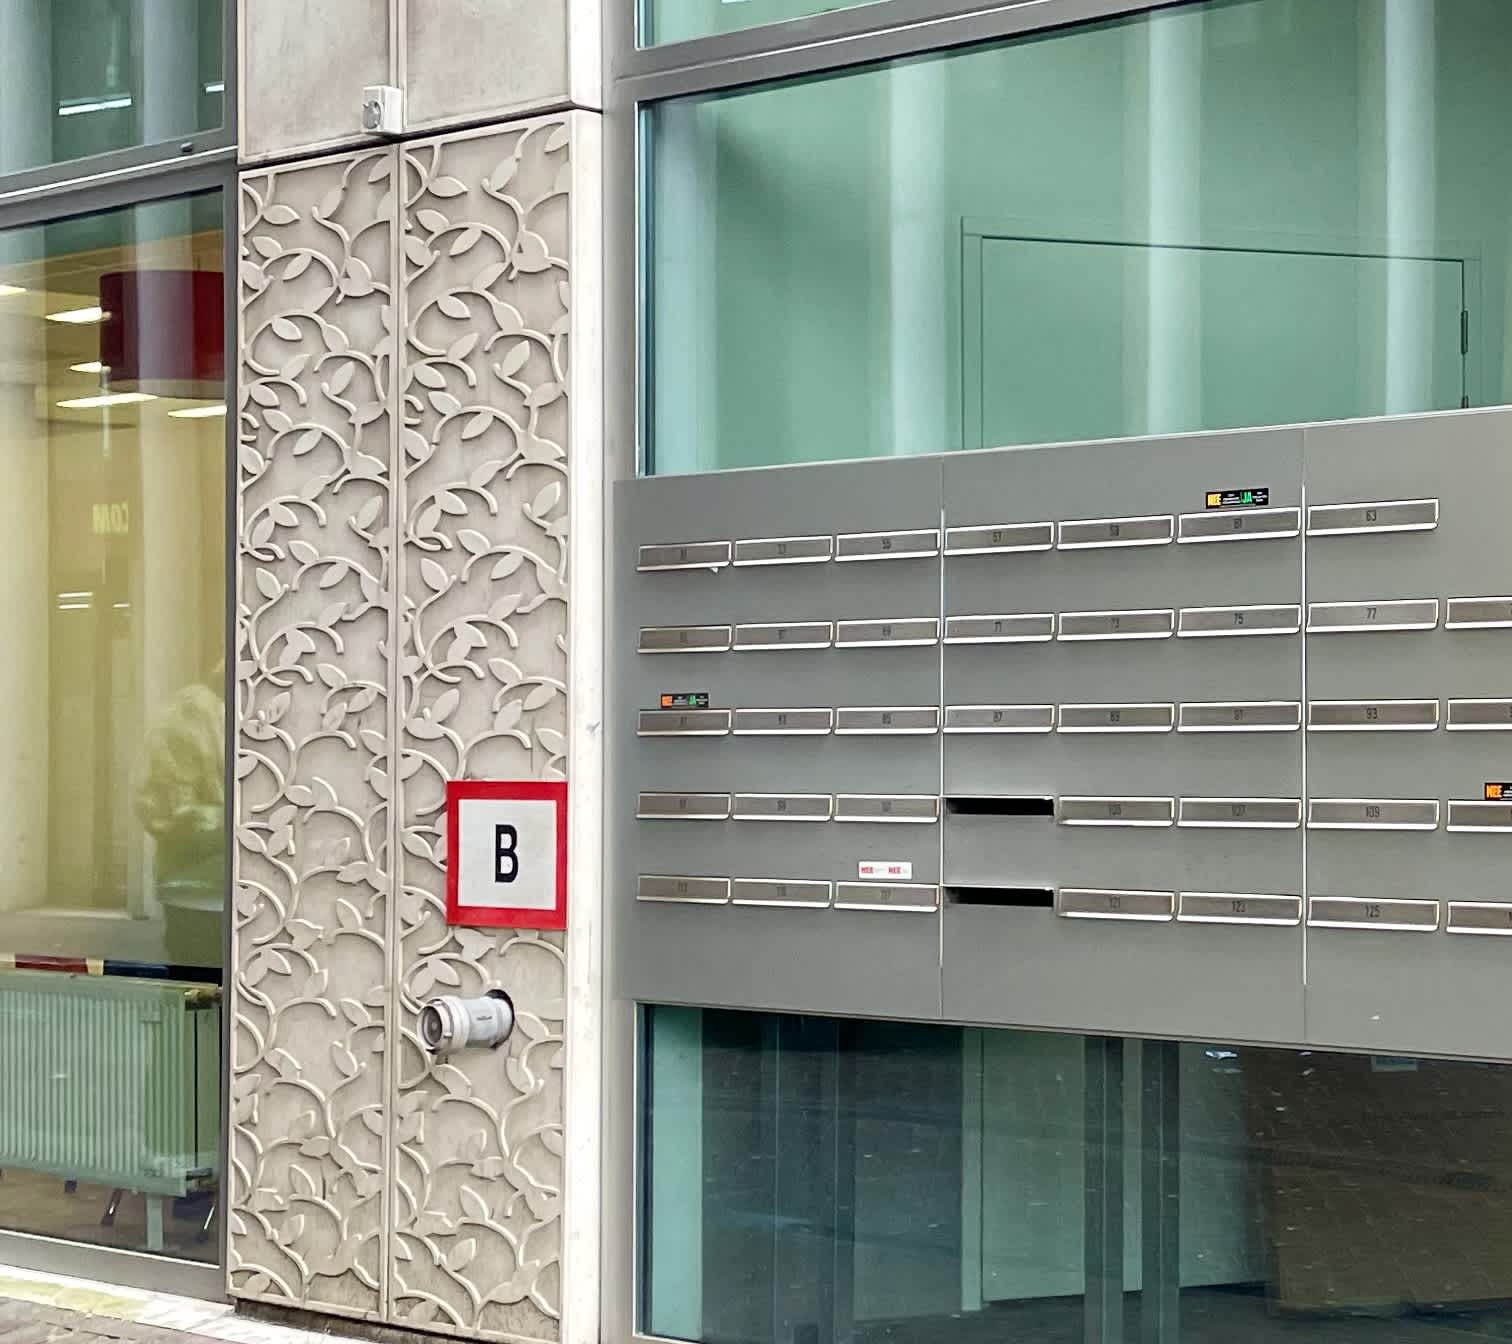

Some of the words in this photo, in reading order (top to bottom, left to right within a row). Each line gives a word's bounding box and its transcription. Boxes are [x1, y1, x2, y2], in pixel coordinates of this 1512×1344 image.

[1235, 613, 1243, 624] 75
[1368, 608, 1376, 619] 77
[1367, 708, 1377, 719] 93
[1366, 806, 1380, 818] 109
[495, 824, 519, 882] B
[1232, 901, 1245, 912] 123
[1366, 905, 1380, 918] 125
